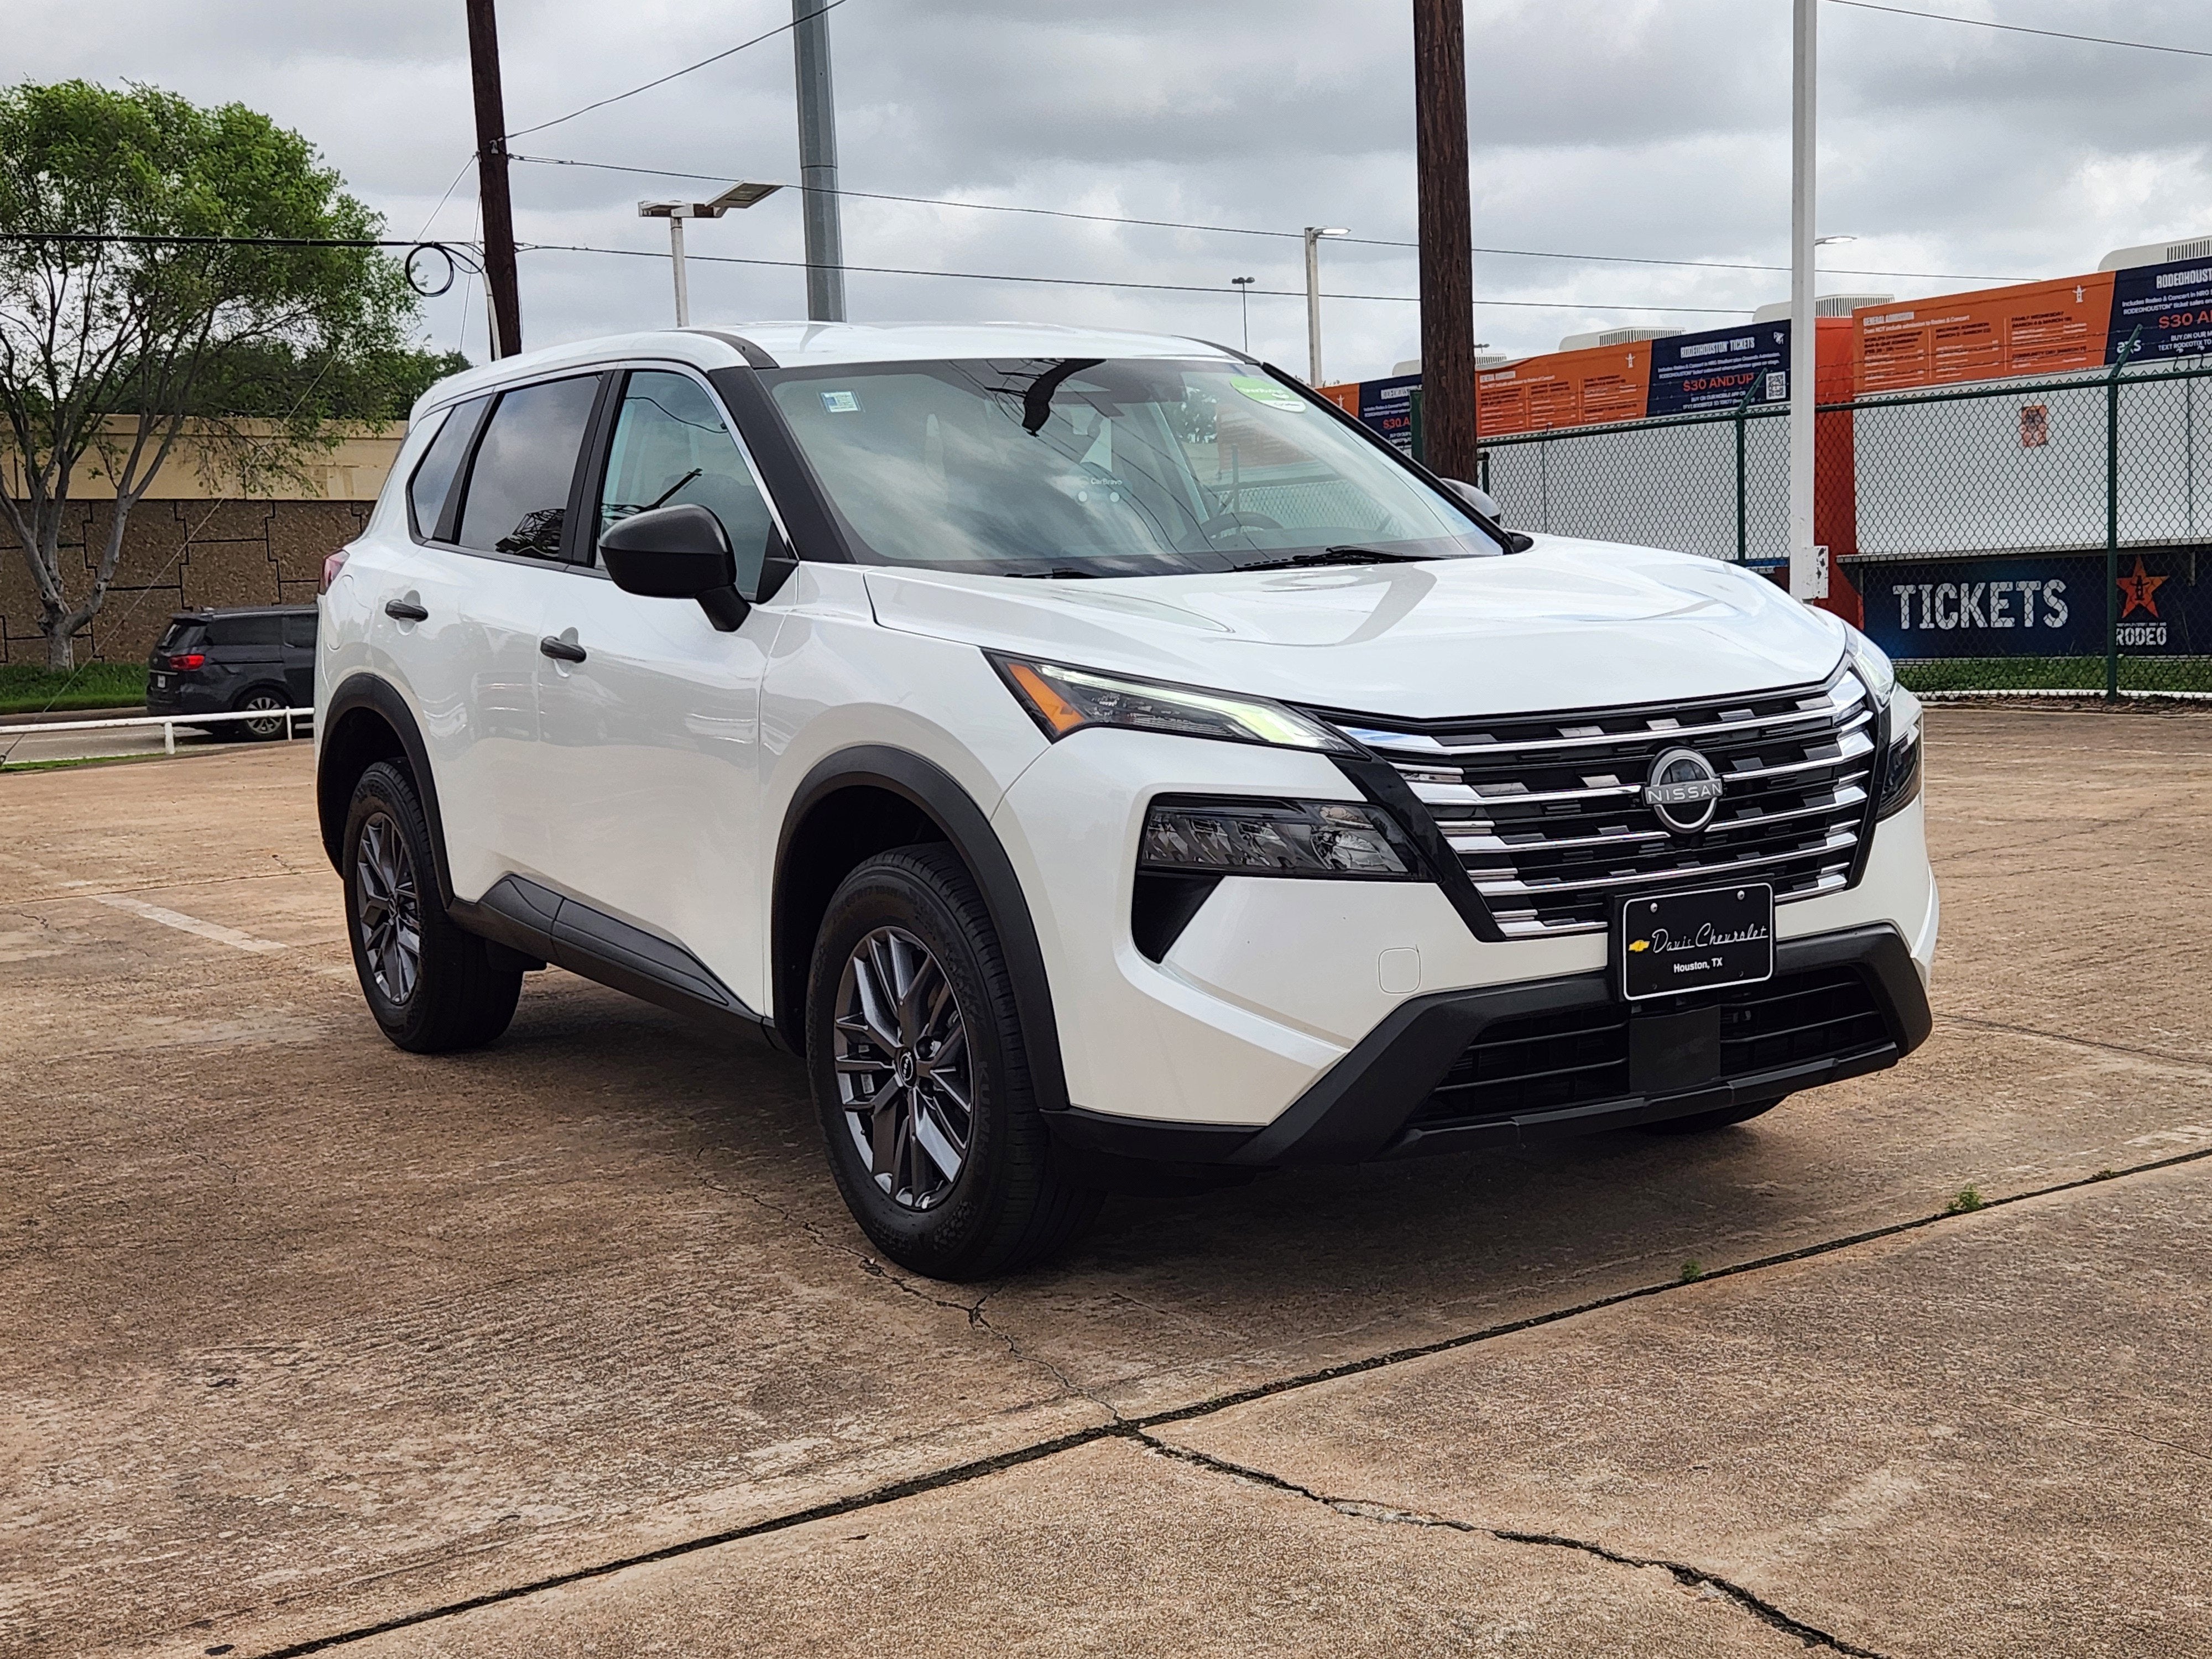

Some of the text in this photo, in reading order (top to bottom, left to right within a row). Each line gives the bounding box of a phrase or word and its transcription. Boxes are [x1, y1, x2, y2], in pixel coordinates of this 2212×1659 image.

[1709, 375, 1735, 388] AND
[1738, 372, 1754, 385] UP
[1892, 578, 2068, 630] TICKETS
[2116, 627, 2167, 646] RODEO
[1647, 782, 1721, 802] NISSAN
[1651, 922, 1768, 953] Davis Chevrolet
[1673, 957, 1723, 973] Houston, TX
[975, 1061, 990, 1176] KUMHO
